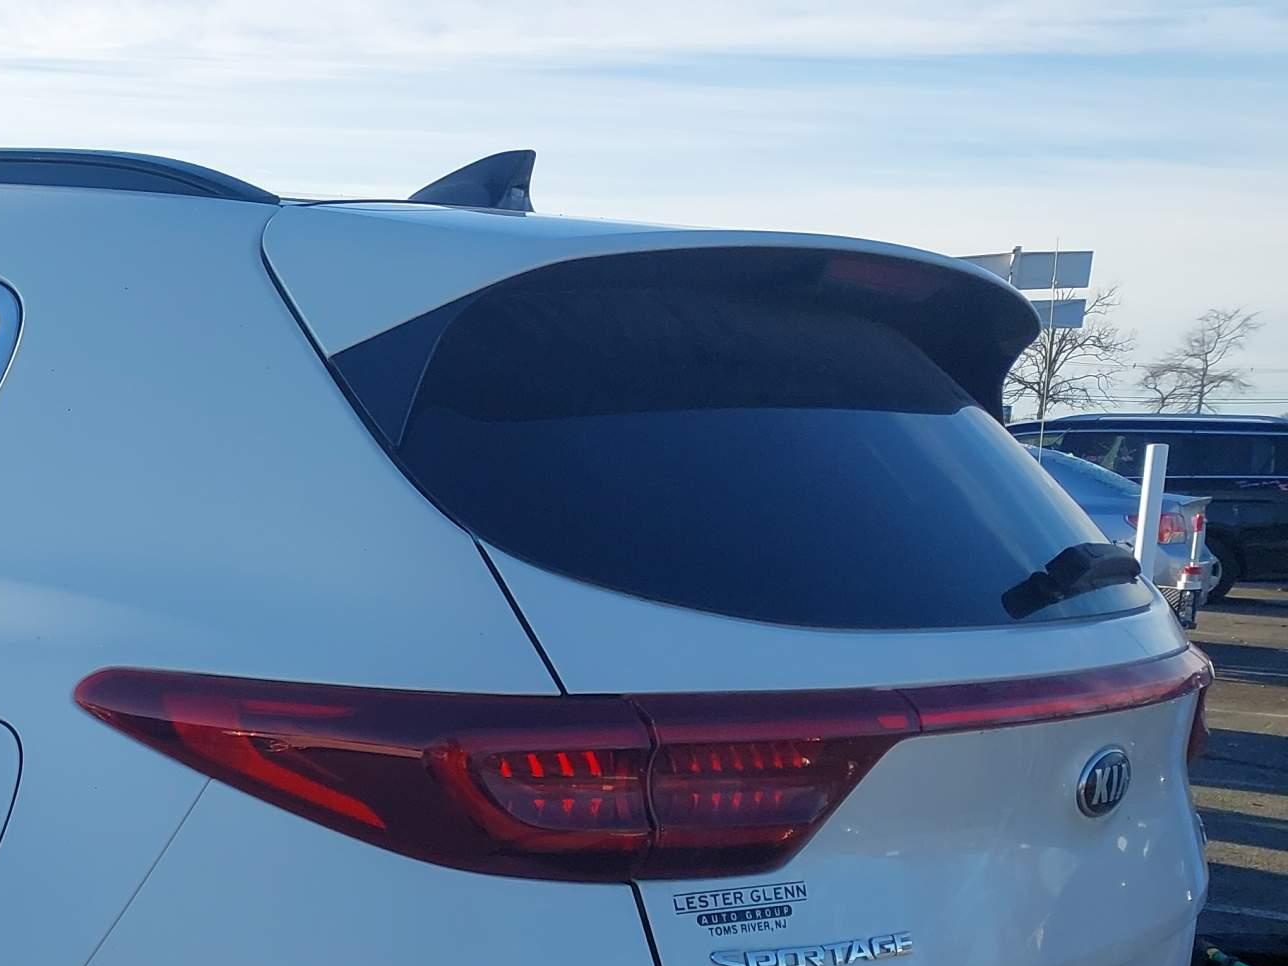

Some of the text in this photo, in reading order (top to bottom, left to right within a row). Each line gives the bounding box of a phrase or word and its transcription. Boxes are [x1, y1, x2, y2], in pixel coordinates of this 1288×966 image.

[673, 883, 807, 912] LESTER GLENN
[700, 906, 790, 926] AUTO GROUP
[708, 918, 787, 937] TOMS RIVER, NJ
